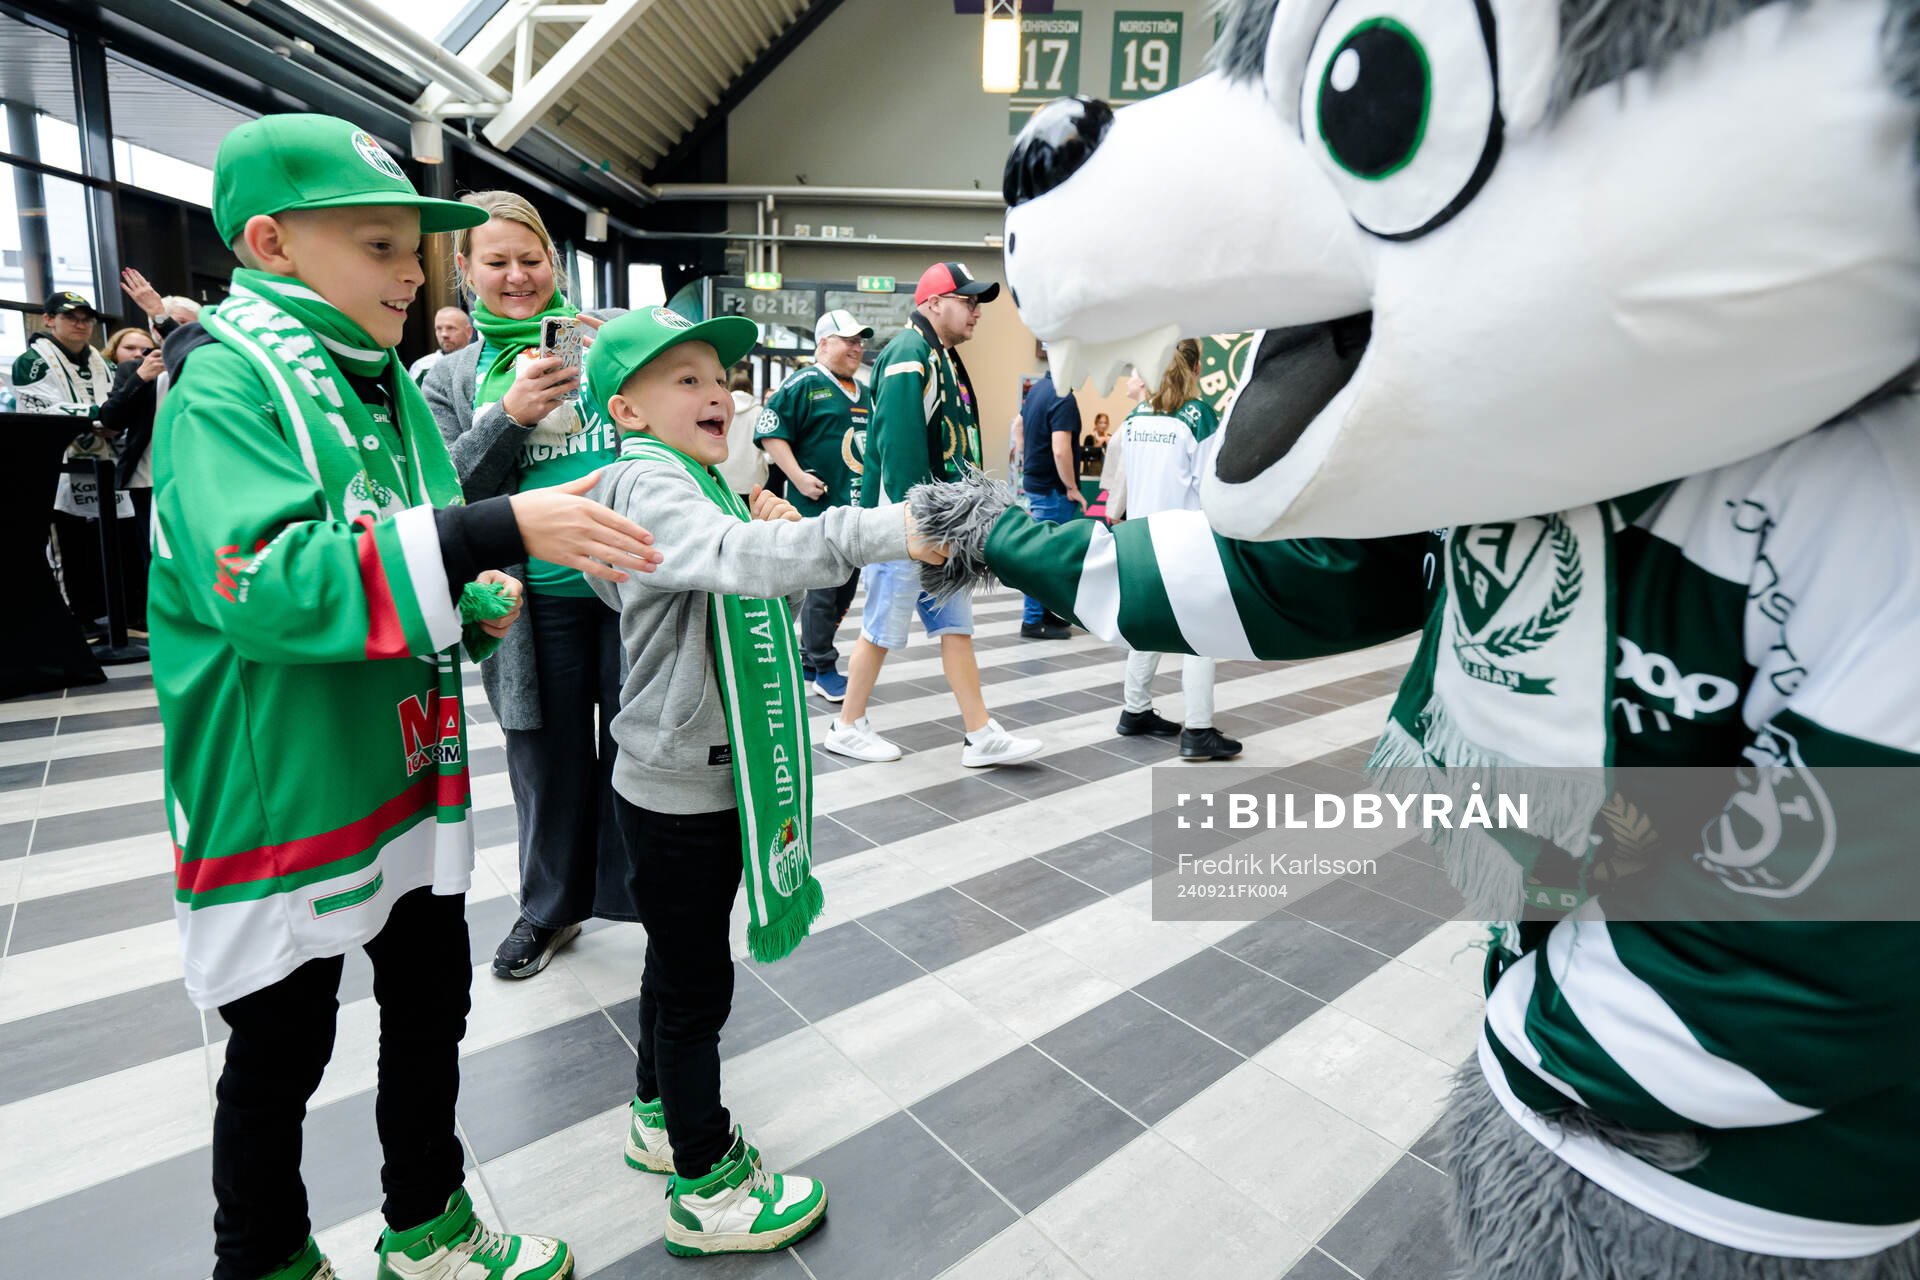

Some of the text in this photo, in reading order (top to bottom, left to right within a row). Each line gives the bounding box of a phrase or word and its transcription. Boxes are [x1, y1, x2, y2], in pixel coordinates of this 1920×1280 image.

[1119, 19, 1178, 34] NORDSTRÖM
[1023, 39, 1069, 90] 17
[1121, 39, 1169, 91] 19
[722, 293, 809, 315] F2 G2 H2
[739, 595, 794, 806] UPP TILL HAL
